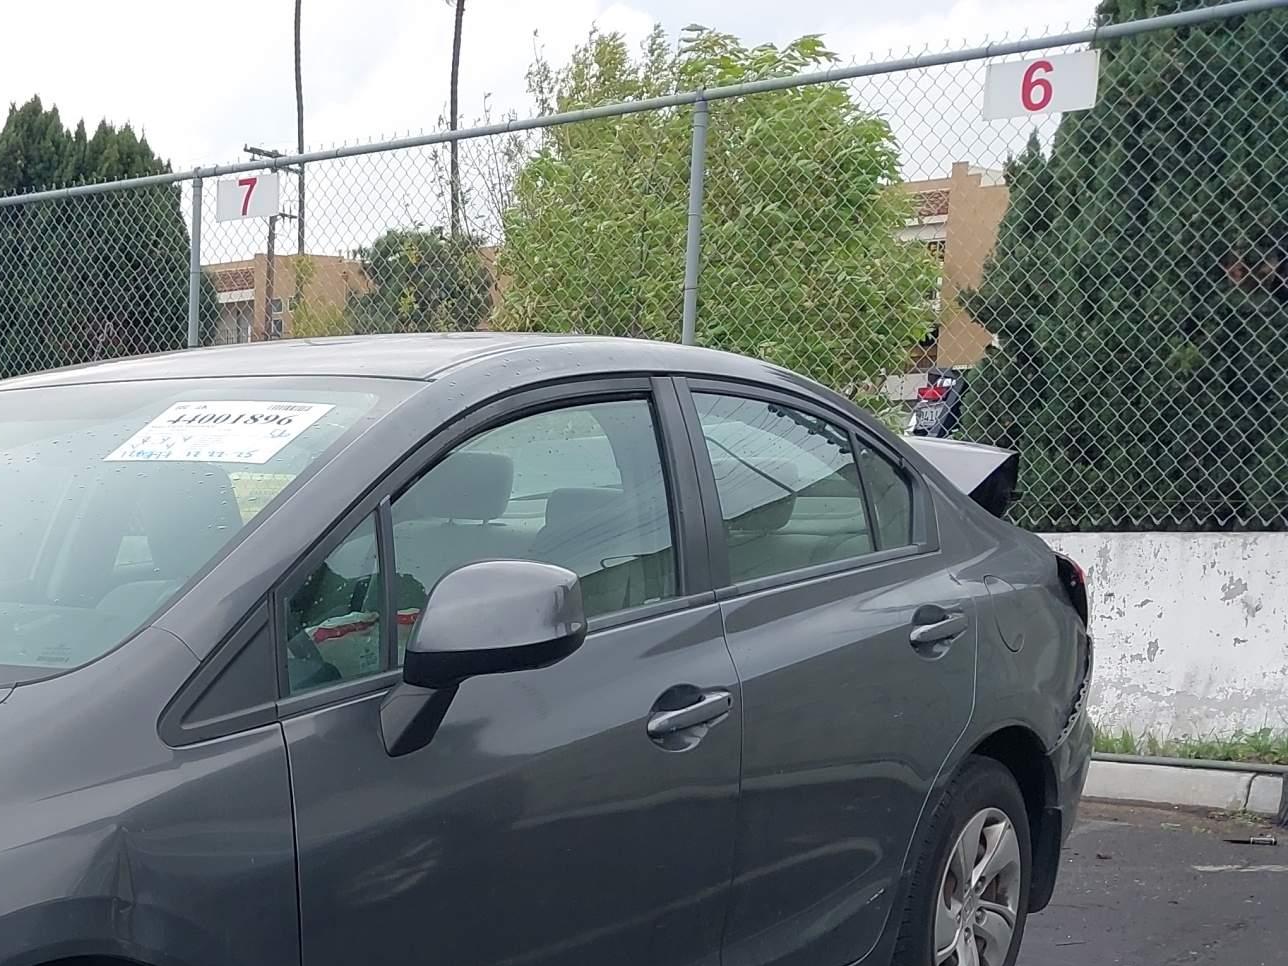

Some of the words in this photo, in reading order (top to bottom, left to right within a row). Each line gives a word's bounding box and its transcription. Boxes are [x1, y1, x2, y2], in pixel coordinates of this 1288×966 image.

[1021, 60, 1054, 112] 6
[238, 177, 257, 216] 7
[167, 413, 295, 425] 44001896
